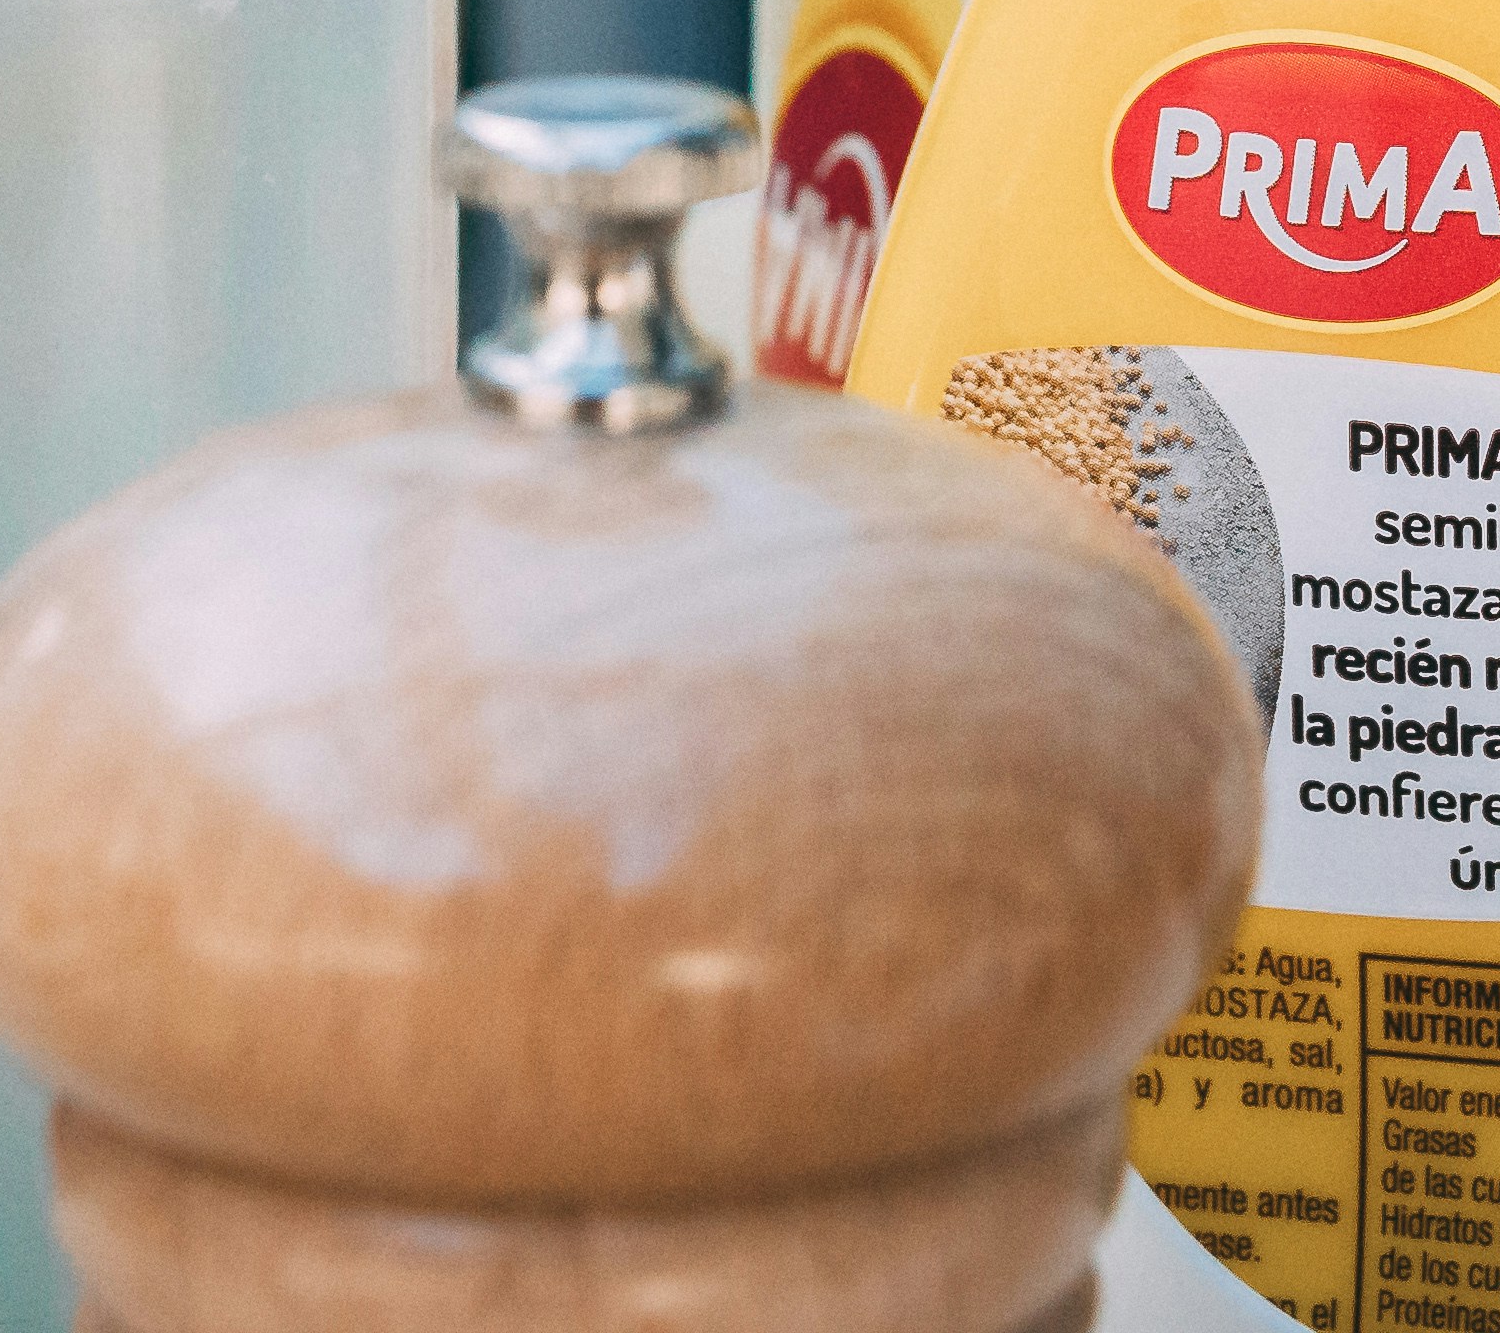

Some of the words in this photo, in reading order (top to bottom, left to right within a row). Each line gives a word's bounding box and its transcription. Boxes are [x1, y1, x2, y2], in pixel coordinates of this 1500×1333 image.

[1313, 637, 1471, 688] recién
[1292, 694, 1335, 746] la
[1256, 947, 1341, 988] Agua,
[1191, 985, 1342, 1034] OSTAZA,
[1154, 1029, 1273, 1069] uctosa,
[1290, 1039, 1342, 1075] sal,
[1195, 1079, 1211, 1109] y
[1242, 1082, 1343, 1114] aroma
[1383, 1077, 1452, 1113] Valor
[1383, 1118, 1476, 1159] Grasas
[1381, 1162, 1416, 1195] de
[1425, 1165, 1463, 1200] las
[1147, 1181, 1249, 1216] mente
[1257, 1190, 1339, 1225] antes
[1381, 1204, 1493, 1247] Hidratos
[1379, 1247, 1412, 1281] de
[1421, 1251, 1459, 1287] los
[1311, 1299, 1338, 1331] el
